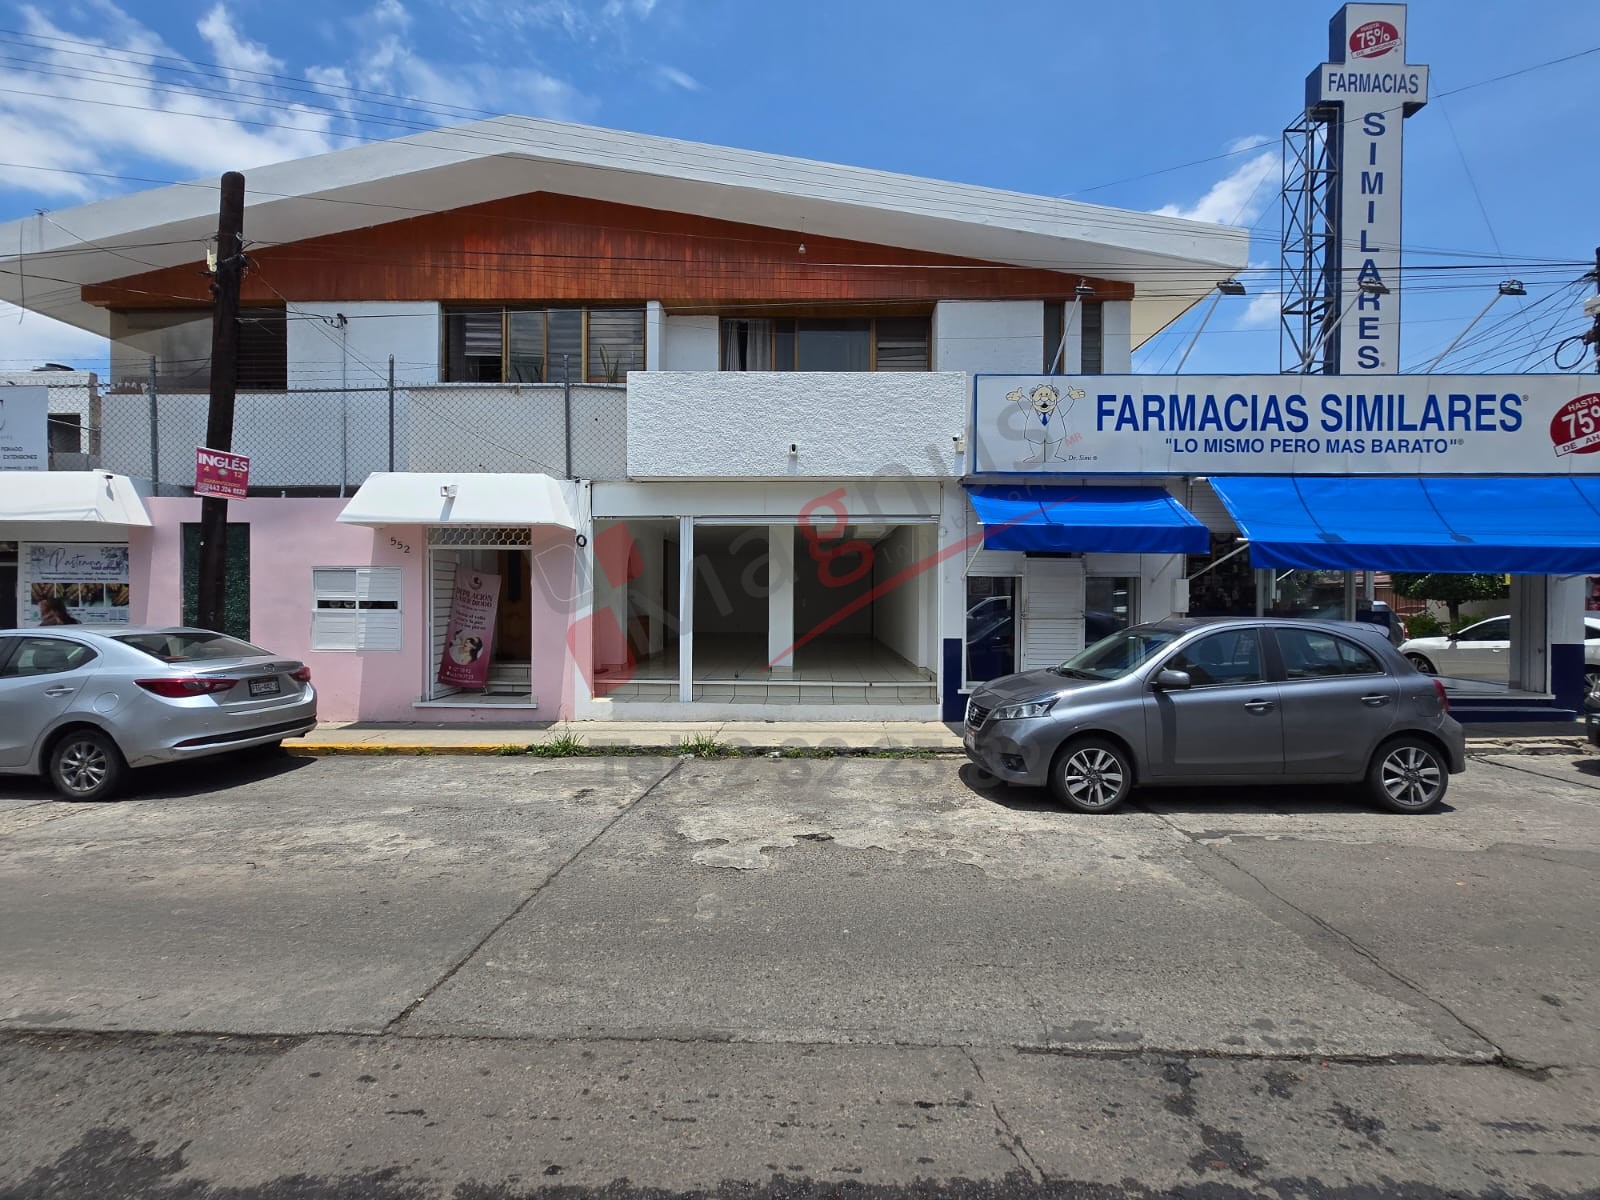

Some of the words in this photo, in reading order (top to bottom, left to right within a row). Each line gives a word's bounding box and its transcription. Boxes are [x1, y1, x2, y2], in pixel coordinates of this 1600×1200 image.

[1356, 26, 1390, 49] 75%
[1328, 73, 1419, 94] FARMACIAS
[1357, 112, 1387, 370] SIMILARES
[1096, 394, 1309, 432] FARMACIAS
[1320, 393, 1523, 432] SIMILARES
[1567, 396, 1600, 413] HASTA
[1204, 438, 1264, 453] MISMO
[1270, 438, 1320, 453] PERO
[1326, 438, 1365, 453] MAS
[1562, 442, 1578, 452] DE
[198, 452, 248, 472] INGLÉS
[390, 536, 410, 554] 552
